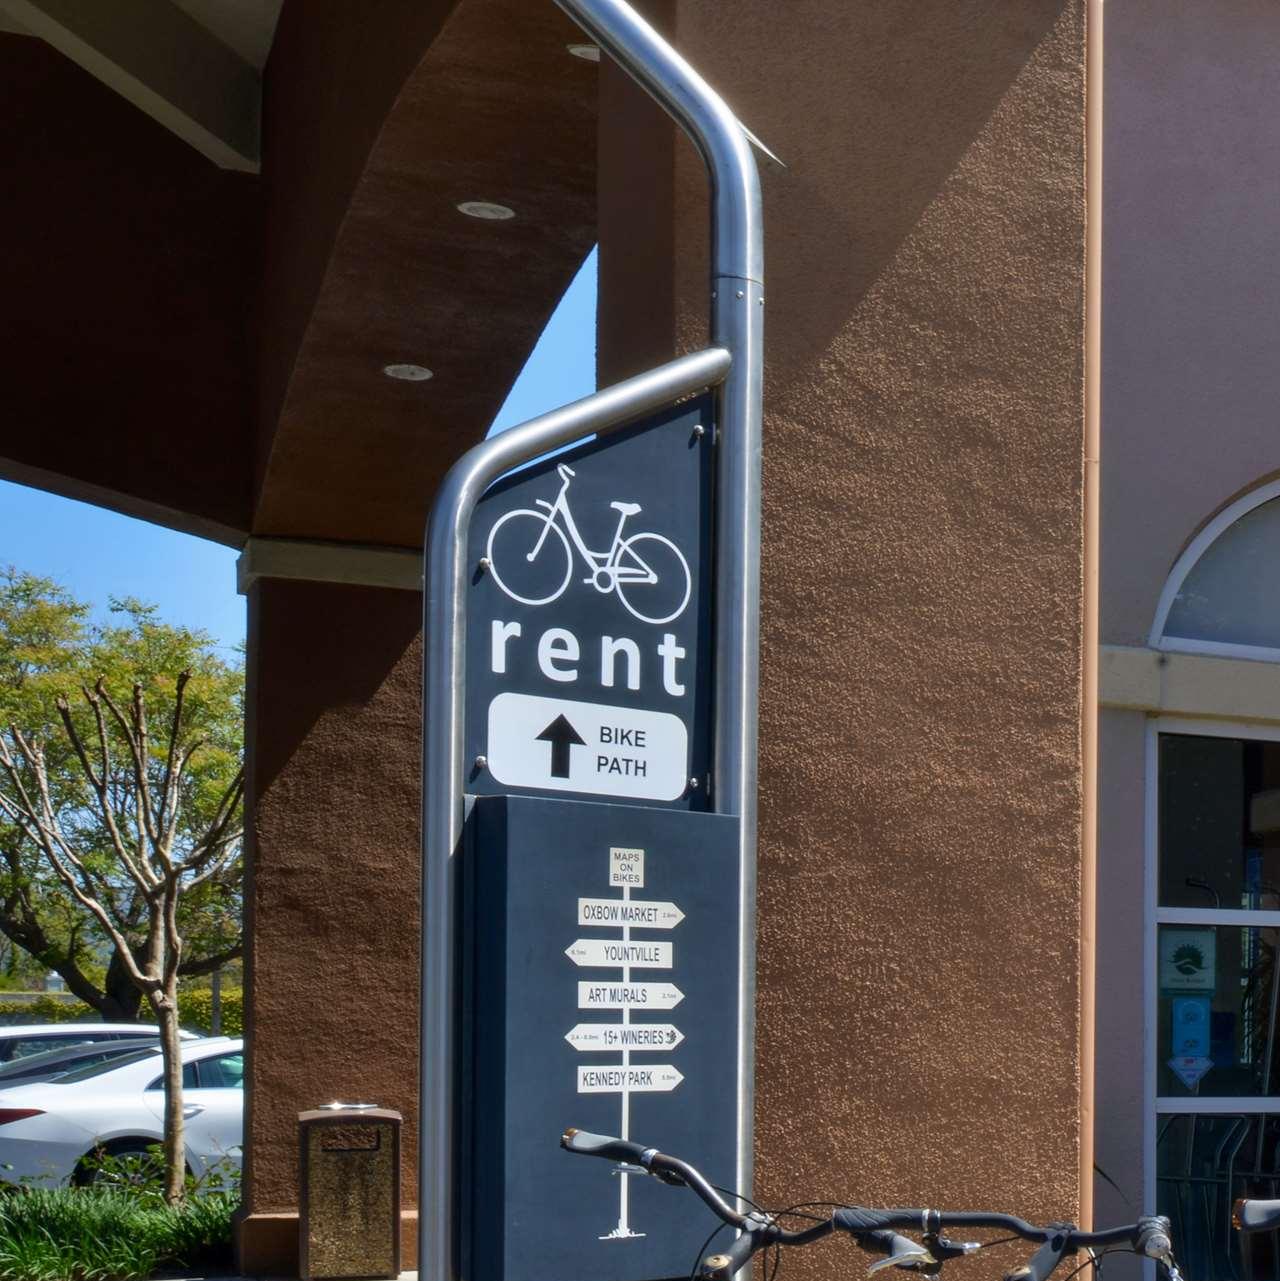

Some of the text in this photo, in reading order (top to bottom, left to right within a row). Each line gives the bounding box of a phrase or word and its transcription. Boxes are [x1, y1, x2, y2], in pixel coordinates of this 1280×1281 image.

[490, 619, 686, 697] rent
[599, 725, 647, 748] BIKE
[596, 755, 647, 777] PATH
[613, 852, 640, 862] MAPS
[619, 863, 634, 872] ON
[612, 873, 640, 883] BIKES
[583, 905, 619, 920] OXBOW
[620, 906, 659, 922] MARKET
[604, 945, 660, 961] YOUNTVILLE
[588, 988, 607, 1003] ART
[609, 988, 648, 1003] MURALS
[603, 1030, 618, 1045] 15+
[620, 1030, 664, 1045] WINERIES
[582, 1071, 653, 1086] KENNEDY PARK
